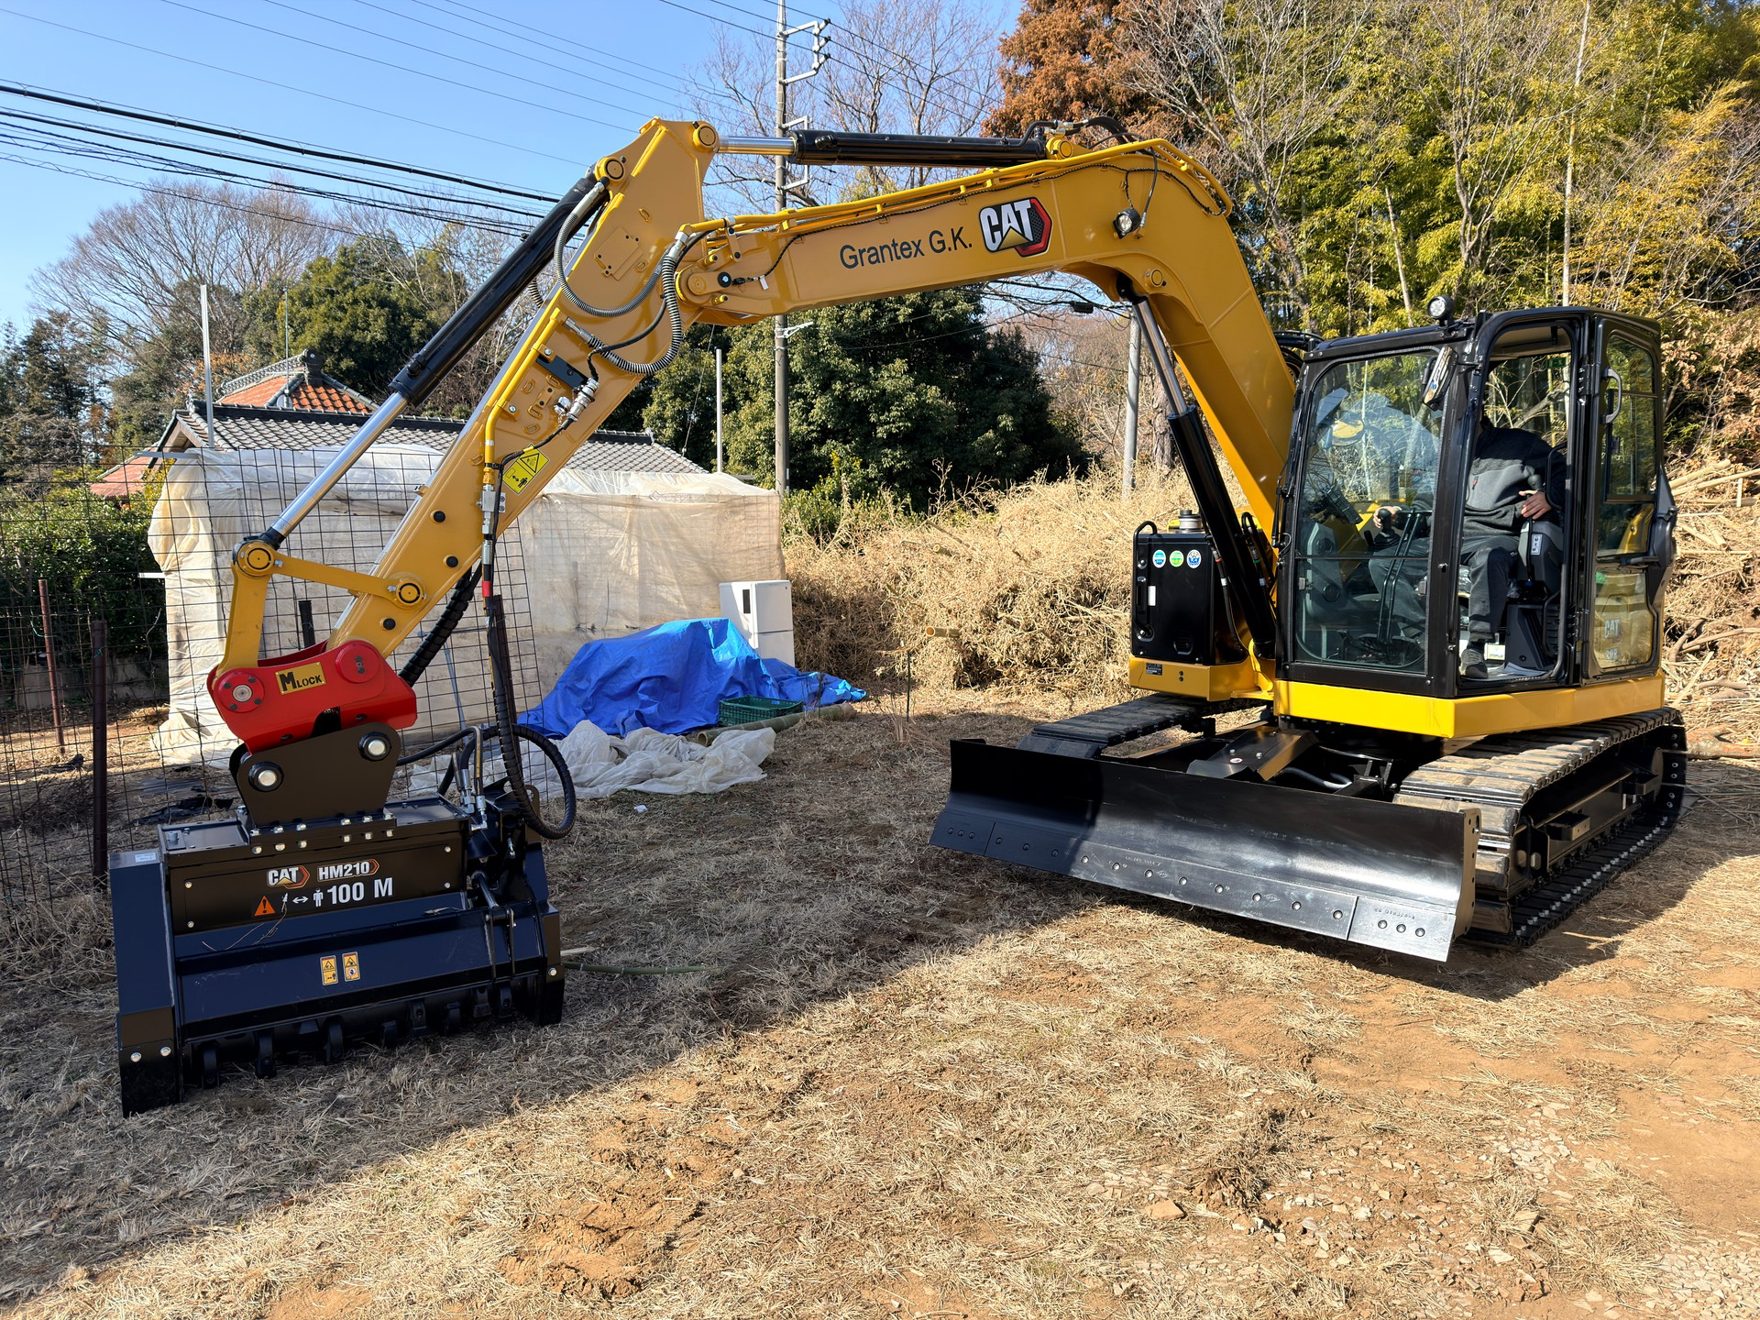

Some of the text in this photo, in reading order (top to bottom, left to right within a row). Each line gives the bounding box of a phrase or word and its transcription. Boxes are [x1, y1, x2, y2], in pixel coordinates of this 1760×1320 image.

[980, 199, 1032, 252] CAT
[840, 226, 972, 269] Grantex G.K.
[1604, 618, 1620, 639] CAT
[268, 861, 370, 886] CAT HM210
[327, 877, 393, 905] 100 M
